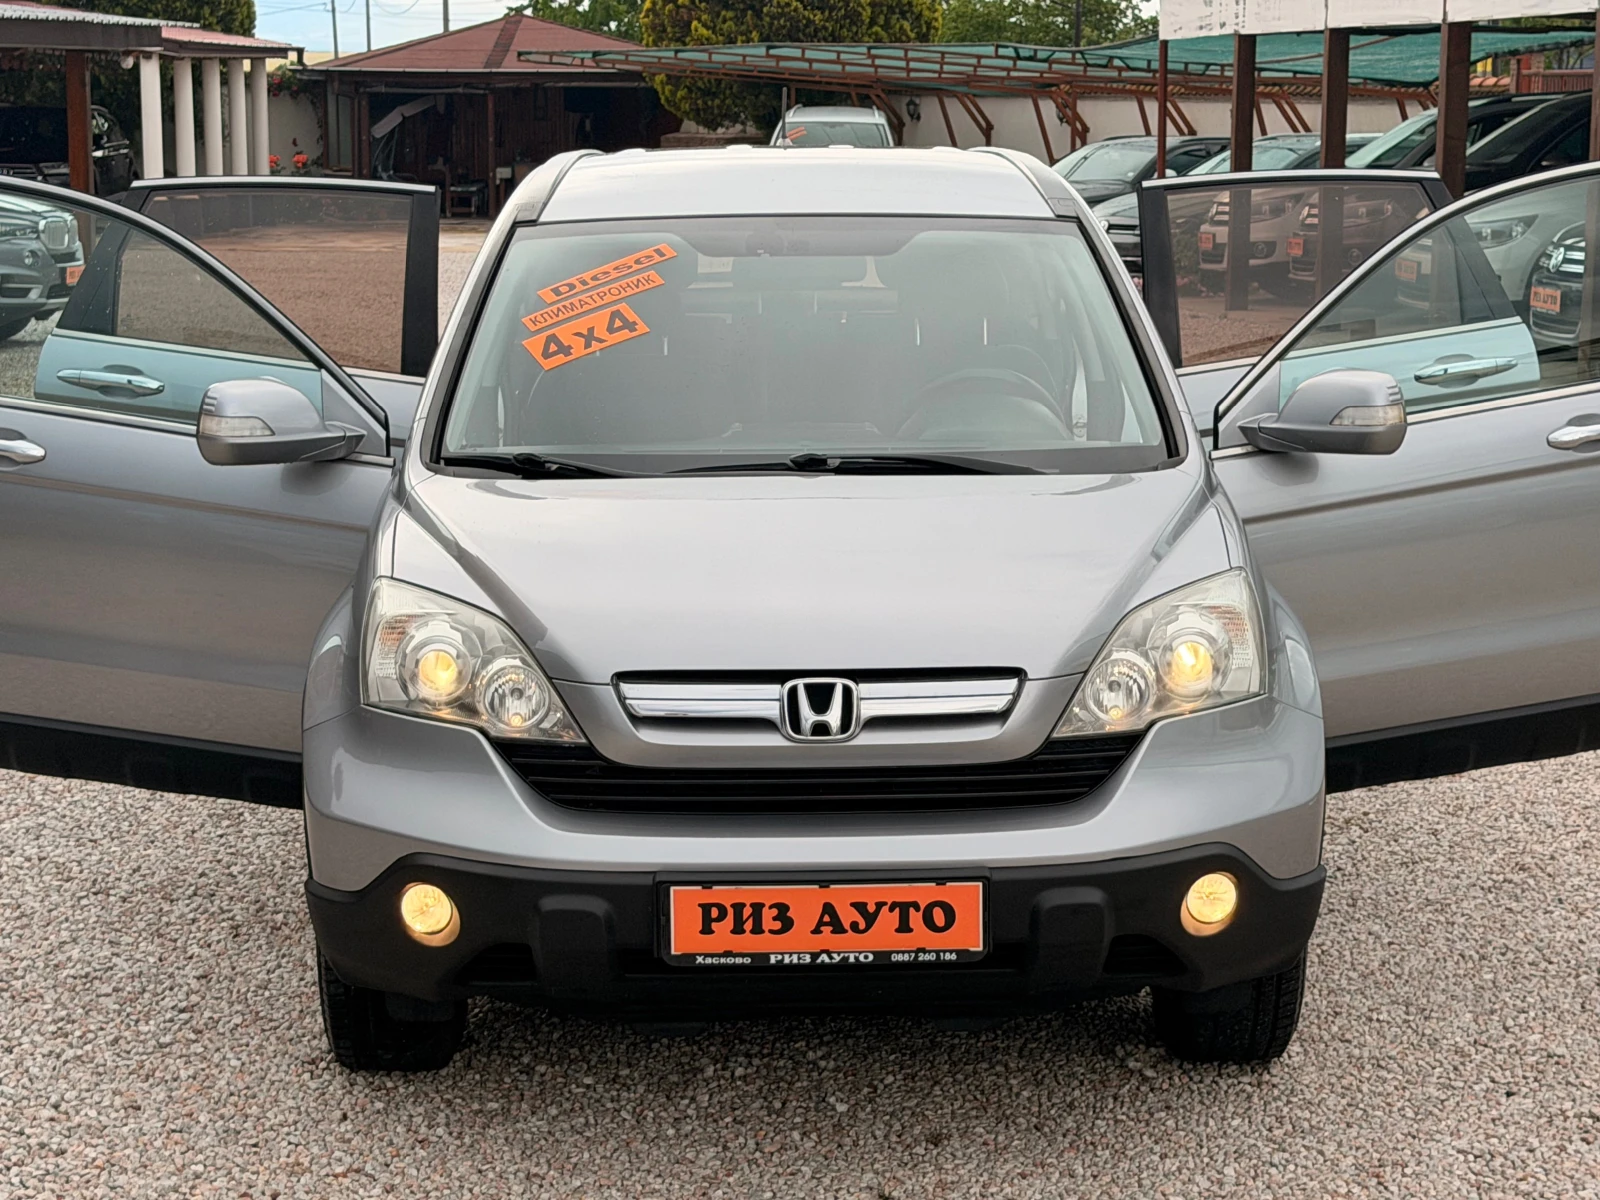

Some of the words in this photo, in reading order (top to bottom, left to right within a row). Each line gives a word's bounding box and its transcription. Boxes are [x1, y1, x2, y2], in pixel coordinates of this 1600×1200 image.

[550, 247, 667, 297] Diesel
[529, 274, 656, 326] КЛИМАТРОНИК
[698, 901, 795, 936] РИЗ
[810, 900, 957, 934] АУТО
[695, 955, 752, 964] Хасково
[769, 953, 812, 964] РИЗ
[815, 952, 875, 963] АУТО
[890, 952, 916, 962] 0887
[917, 952, 937, 961] 260
[939, 951, 958, 961] 186
